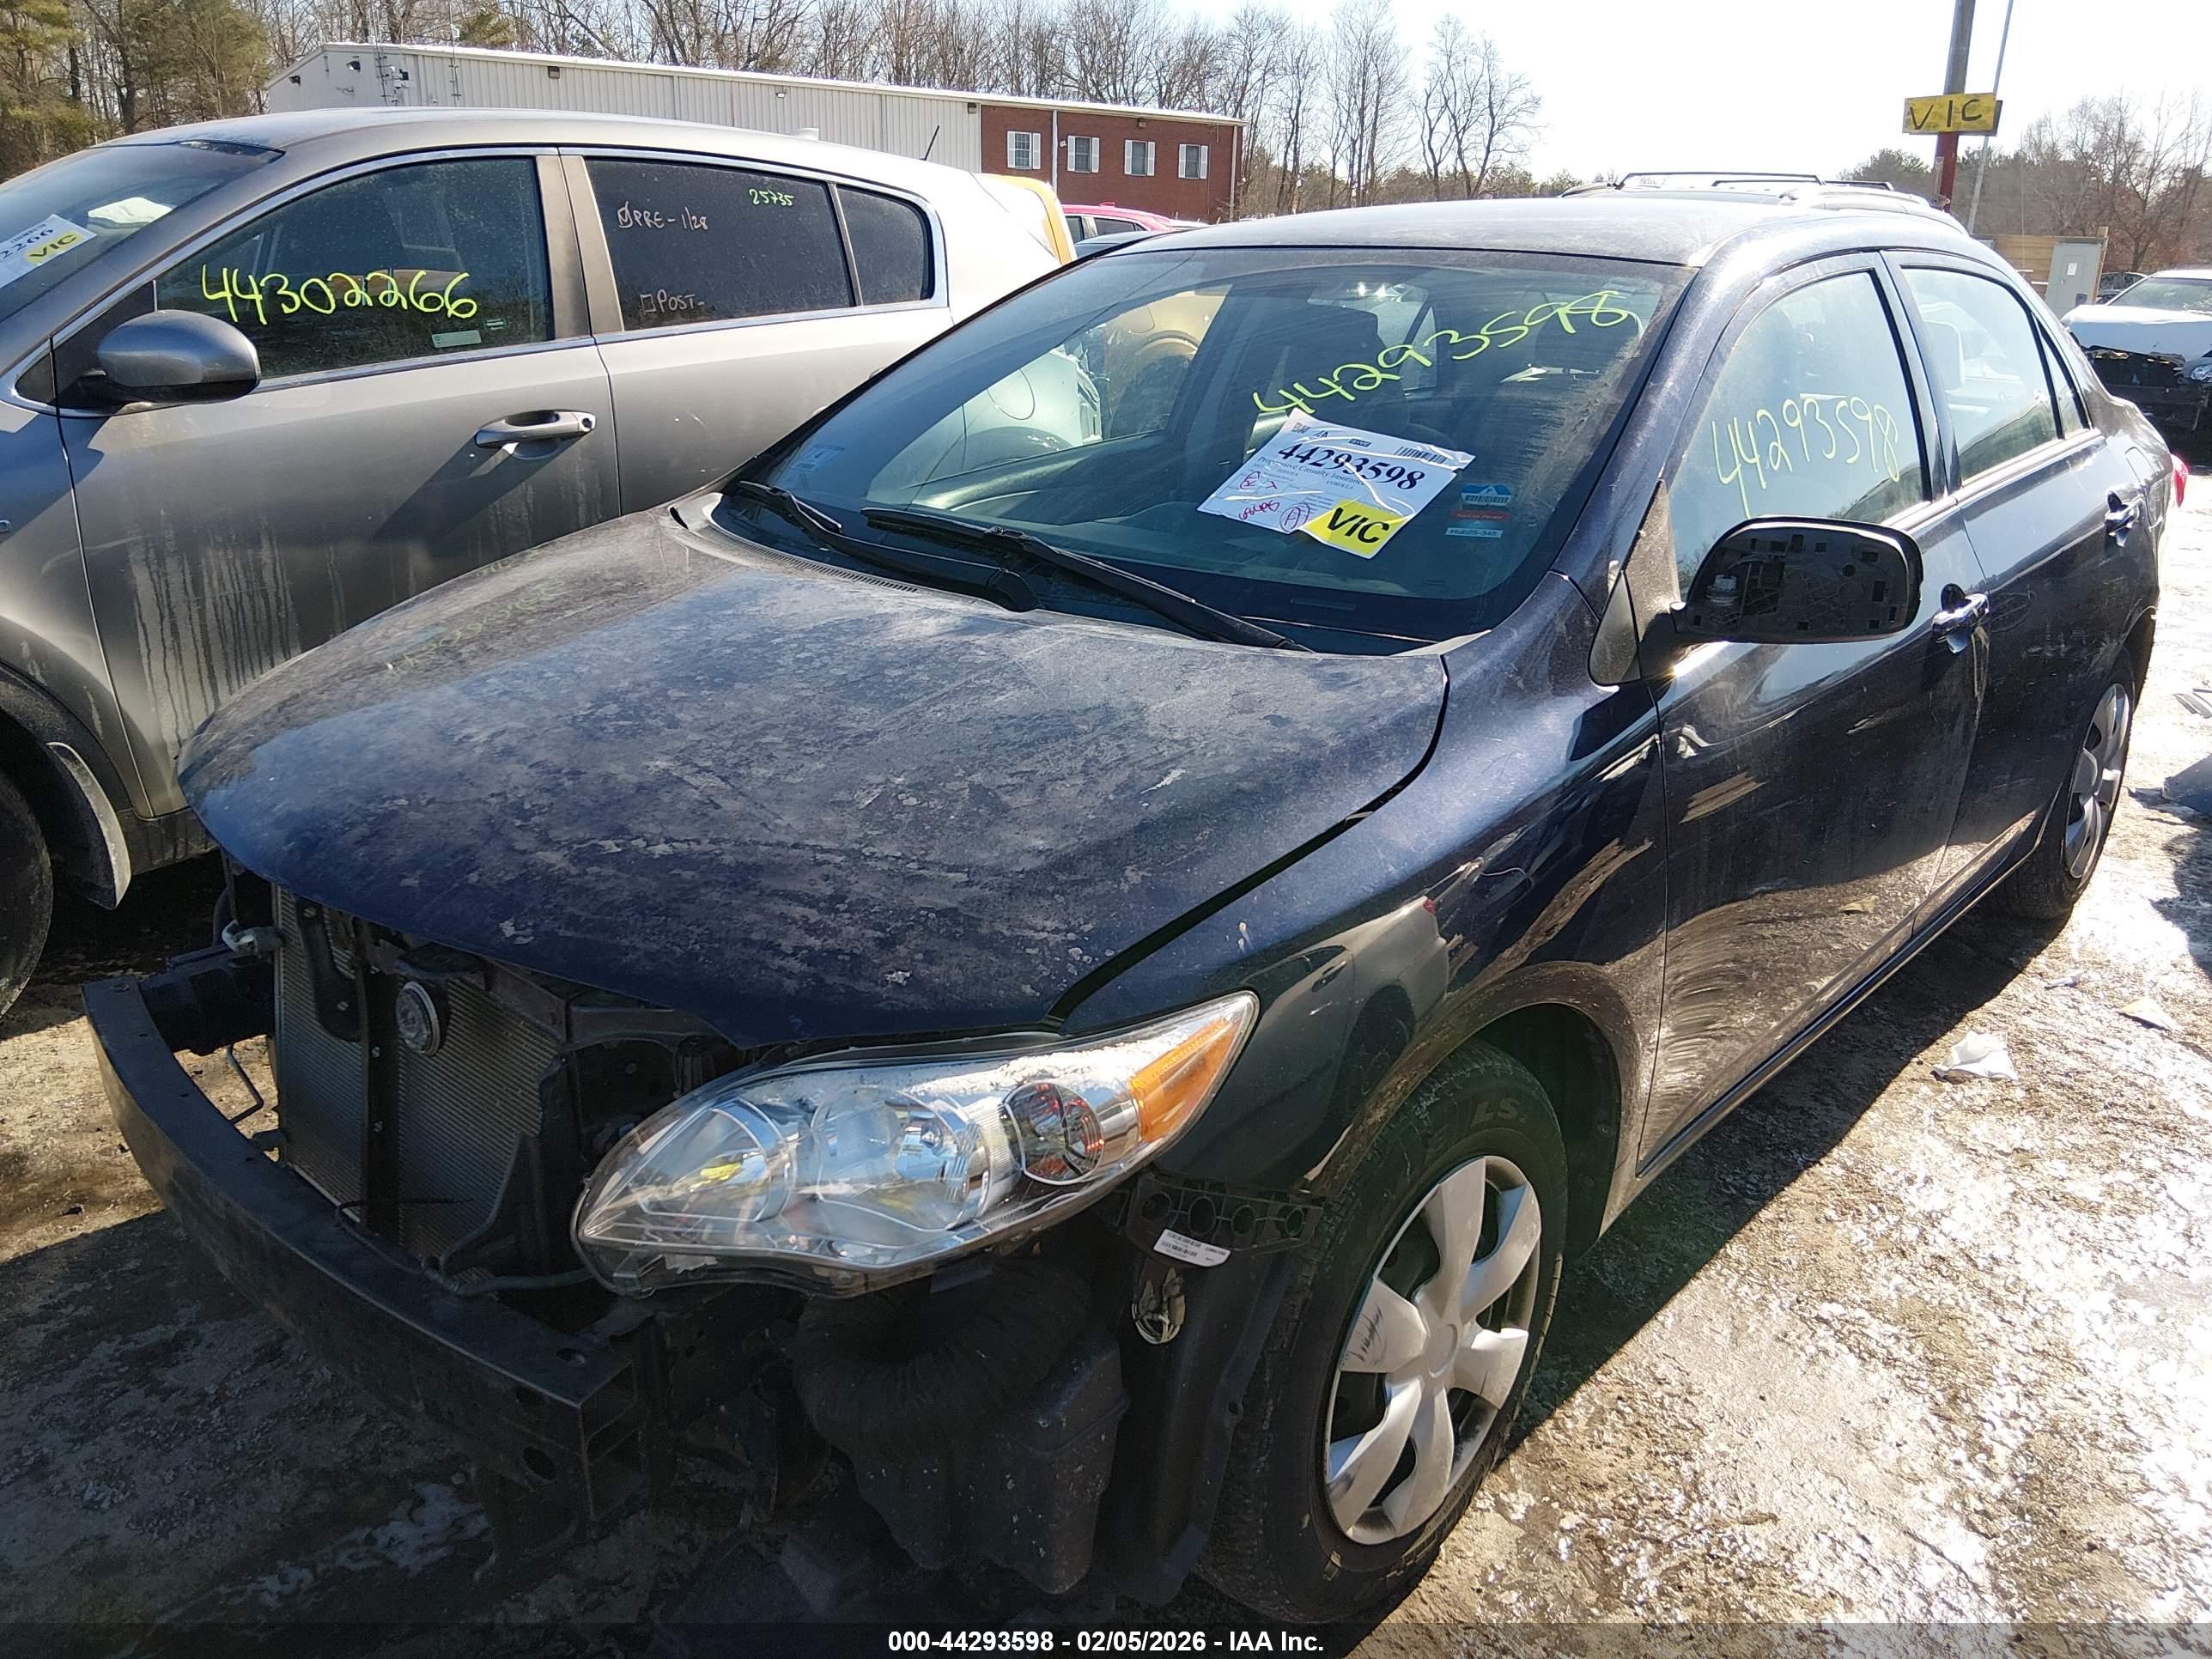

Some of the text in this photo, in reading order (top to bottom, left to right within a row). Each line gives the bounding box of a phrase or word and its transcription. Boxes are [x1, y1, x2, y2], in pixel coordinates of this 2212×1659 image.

[1909, 99, 1983, 131] VIC
[749, 188, 794, 206] 25735
[28, 234, 77, 258] VIC
[202, 264, 477, 325] 44302266
[1252, 290, 1643, 414] 44293598
[1277, 443, 1425, 490] 44293598
[1298, 465, 1329, 478] Casualty
[1711, 393, 1900, 520] 44293598
[1327, 507, 1389, 544] VIC
